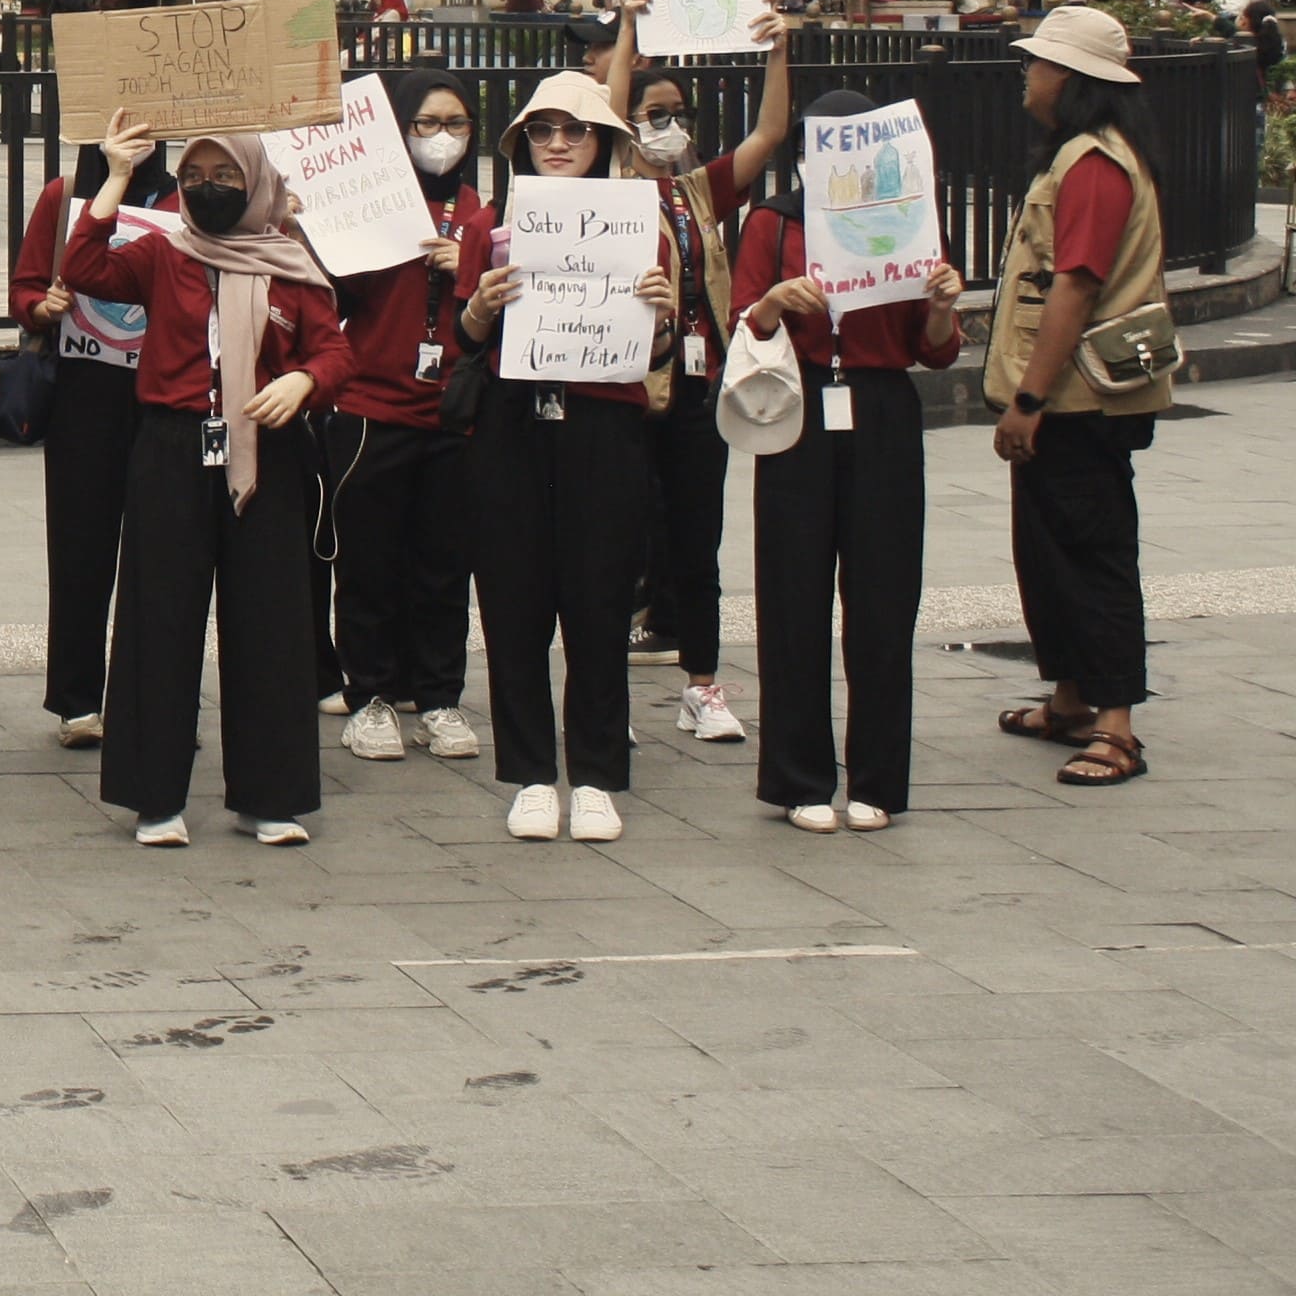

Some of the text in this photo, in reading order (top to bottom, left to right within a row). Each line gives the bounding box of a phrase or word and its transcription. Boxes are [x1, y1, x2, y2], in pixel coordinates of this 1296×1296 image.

[135, 5, 247, 53] STOP
[148, 49, 232, 77] JAGAIN
[300, 137, 368, 182] BUKAN
[517, 210, 564, 235] Satu
[557, 254, 596, 274] Satu
[64, 335, 101, 356] NO
